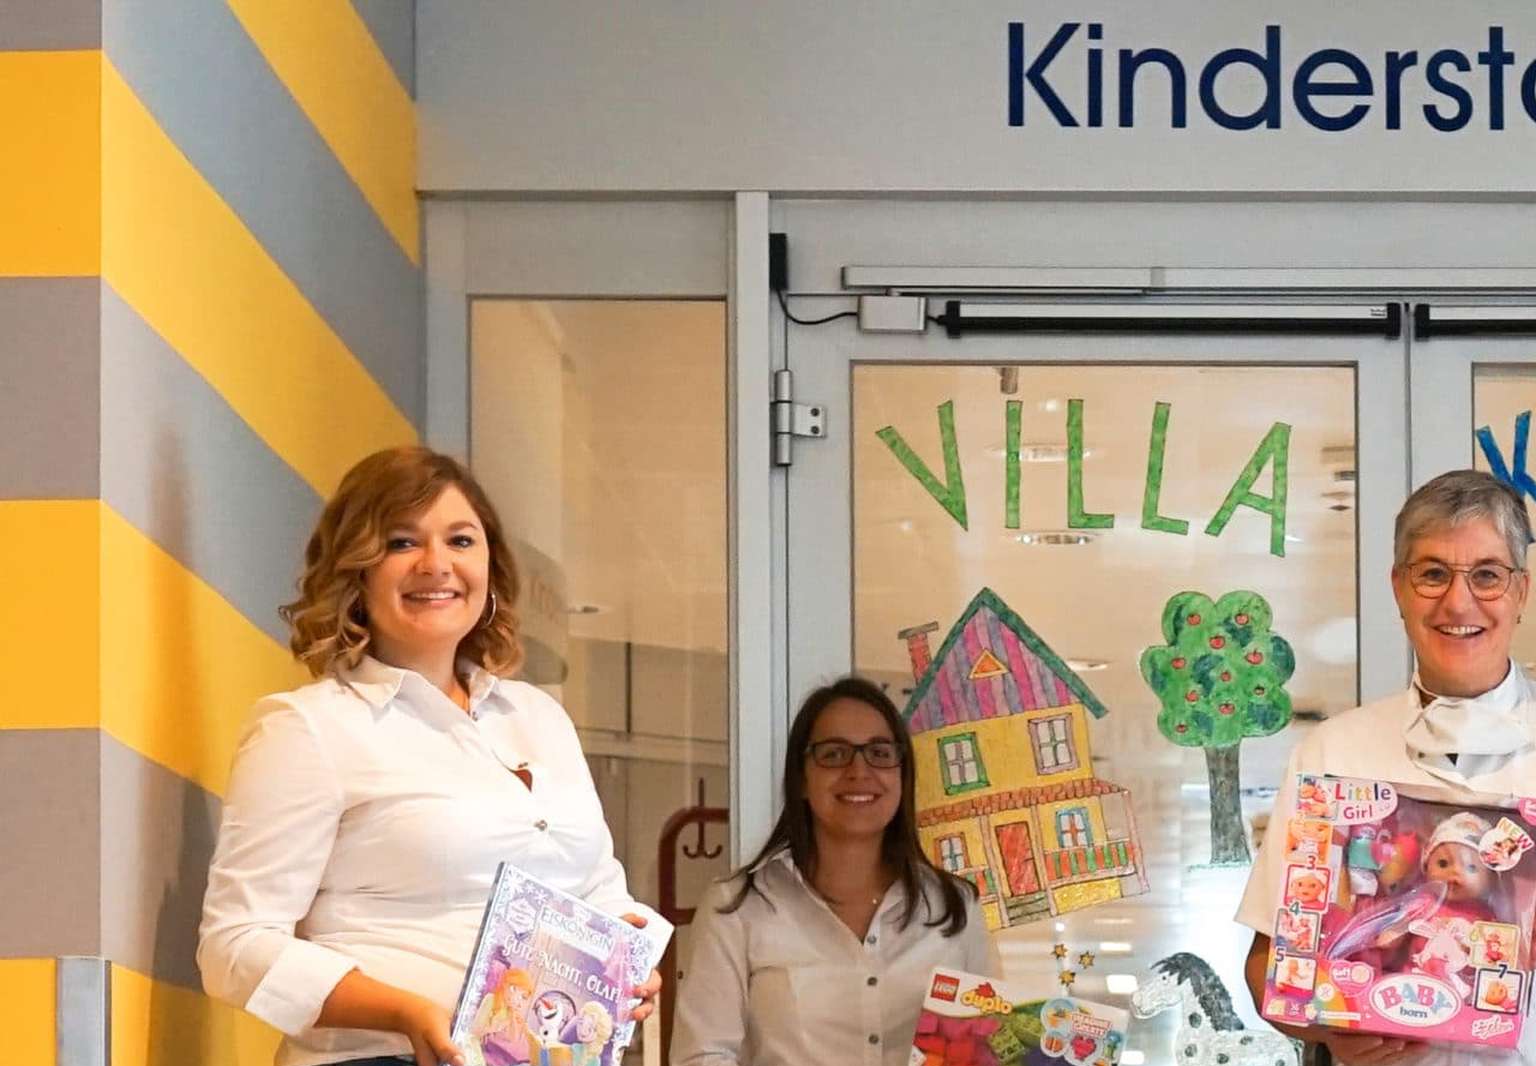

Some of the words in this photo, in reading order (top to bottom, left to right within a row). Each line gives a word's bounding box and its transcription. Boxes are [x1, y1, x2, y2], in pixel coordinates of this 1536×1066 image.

[875, 400, 1291, 558] VILLA
[1334, 783, 1391, 804] Little
[1343, 806, 1373, 821] Girl
[961, 989, 1013, 1015] duplo
[1378, 983, 1454, 1015] BABY
[1400, 1006, 1429, 1019] born
